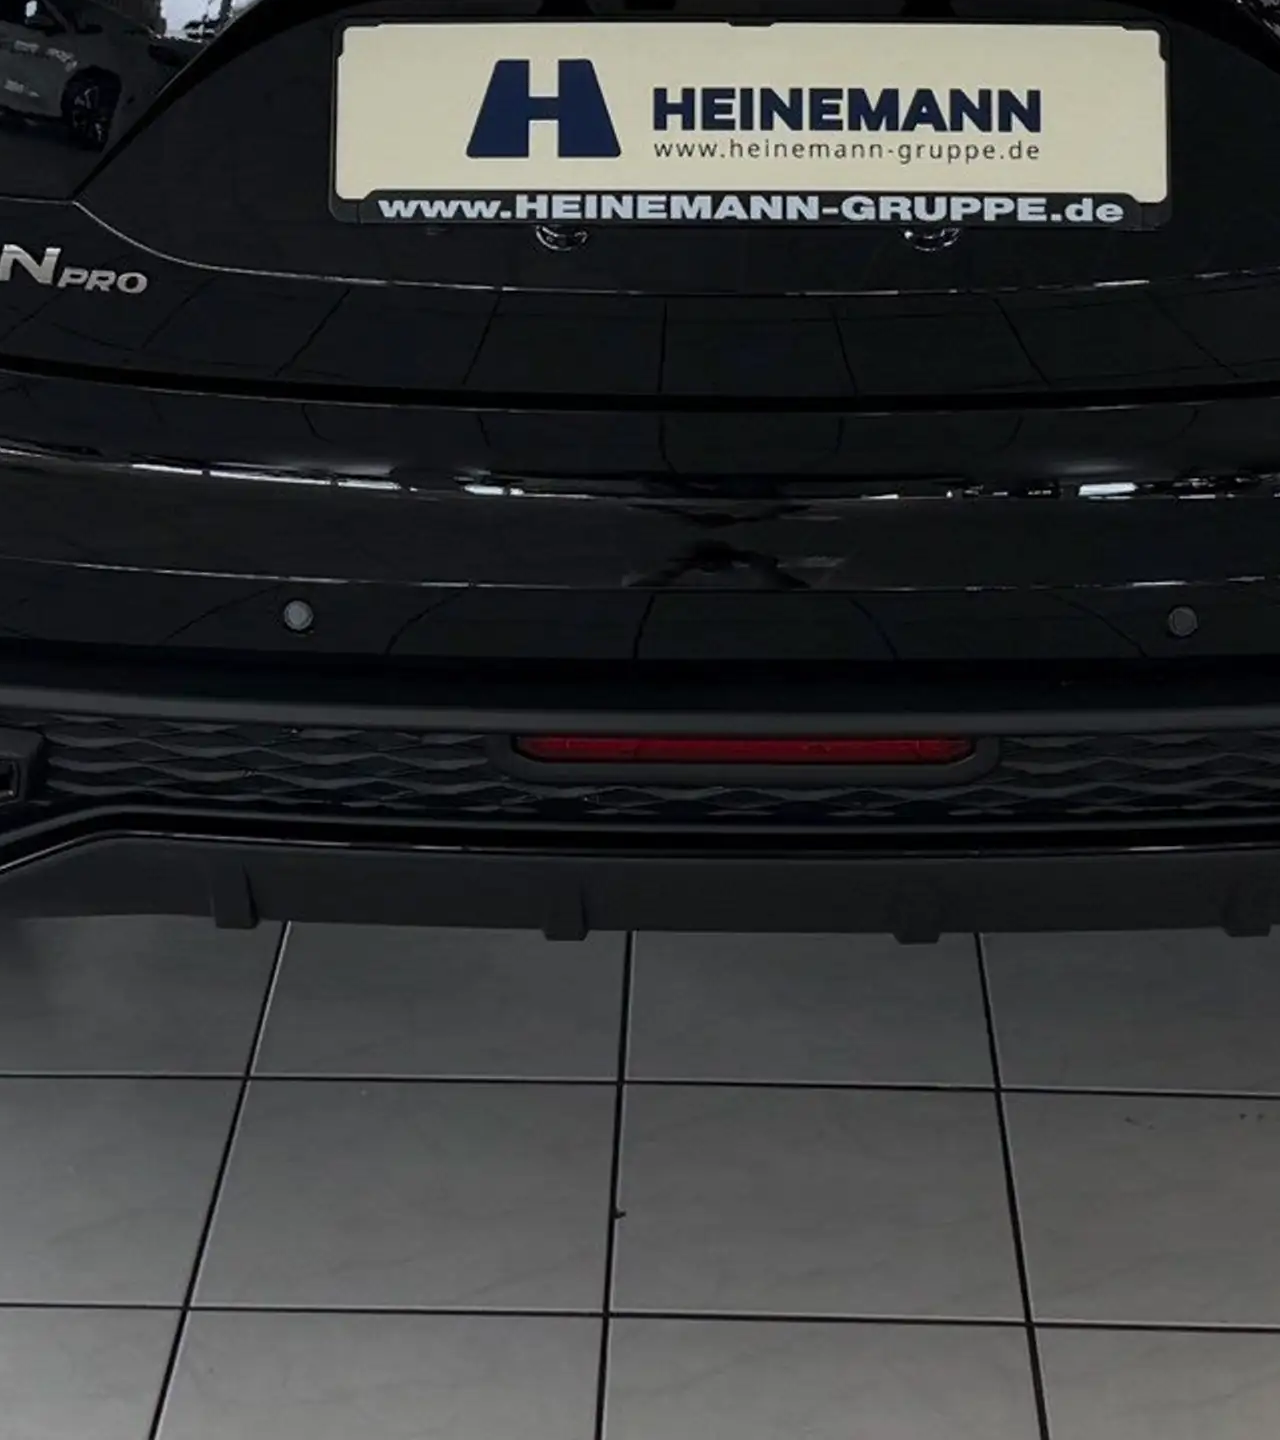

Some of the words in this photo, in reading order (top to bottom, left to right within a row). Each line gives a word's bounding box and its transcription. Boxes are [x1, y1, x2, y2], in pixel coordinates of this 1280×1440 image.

[652, 87, 1041, 133] HEINEMANN
[653, 138, 1040, 165] www.heinemann-gruppe.de
[378, 193, 1125, 223] www.HEINEMANN-GRUPPE.de
[57, 266, 148, 295] PRO
